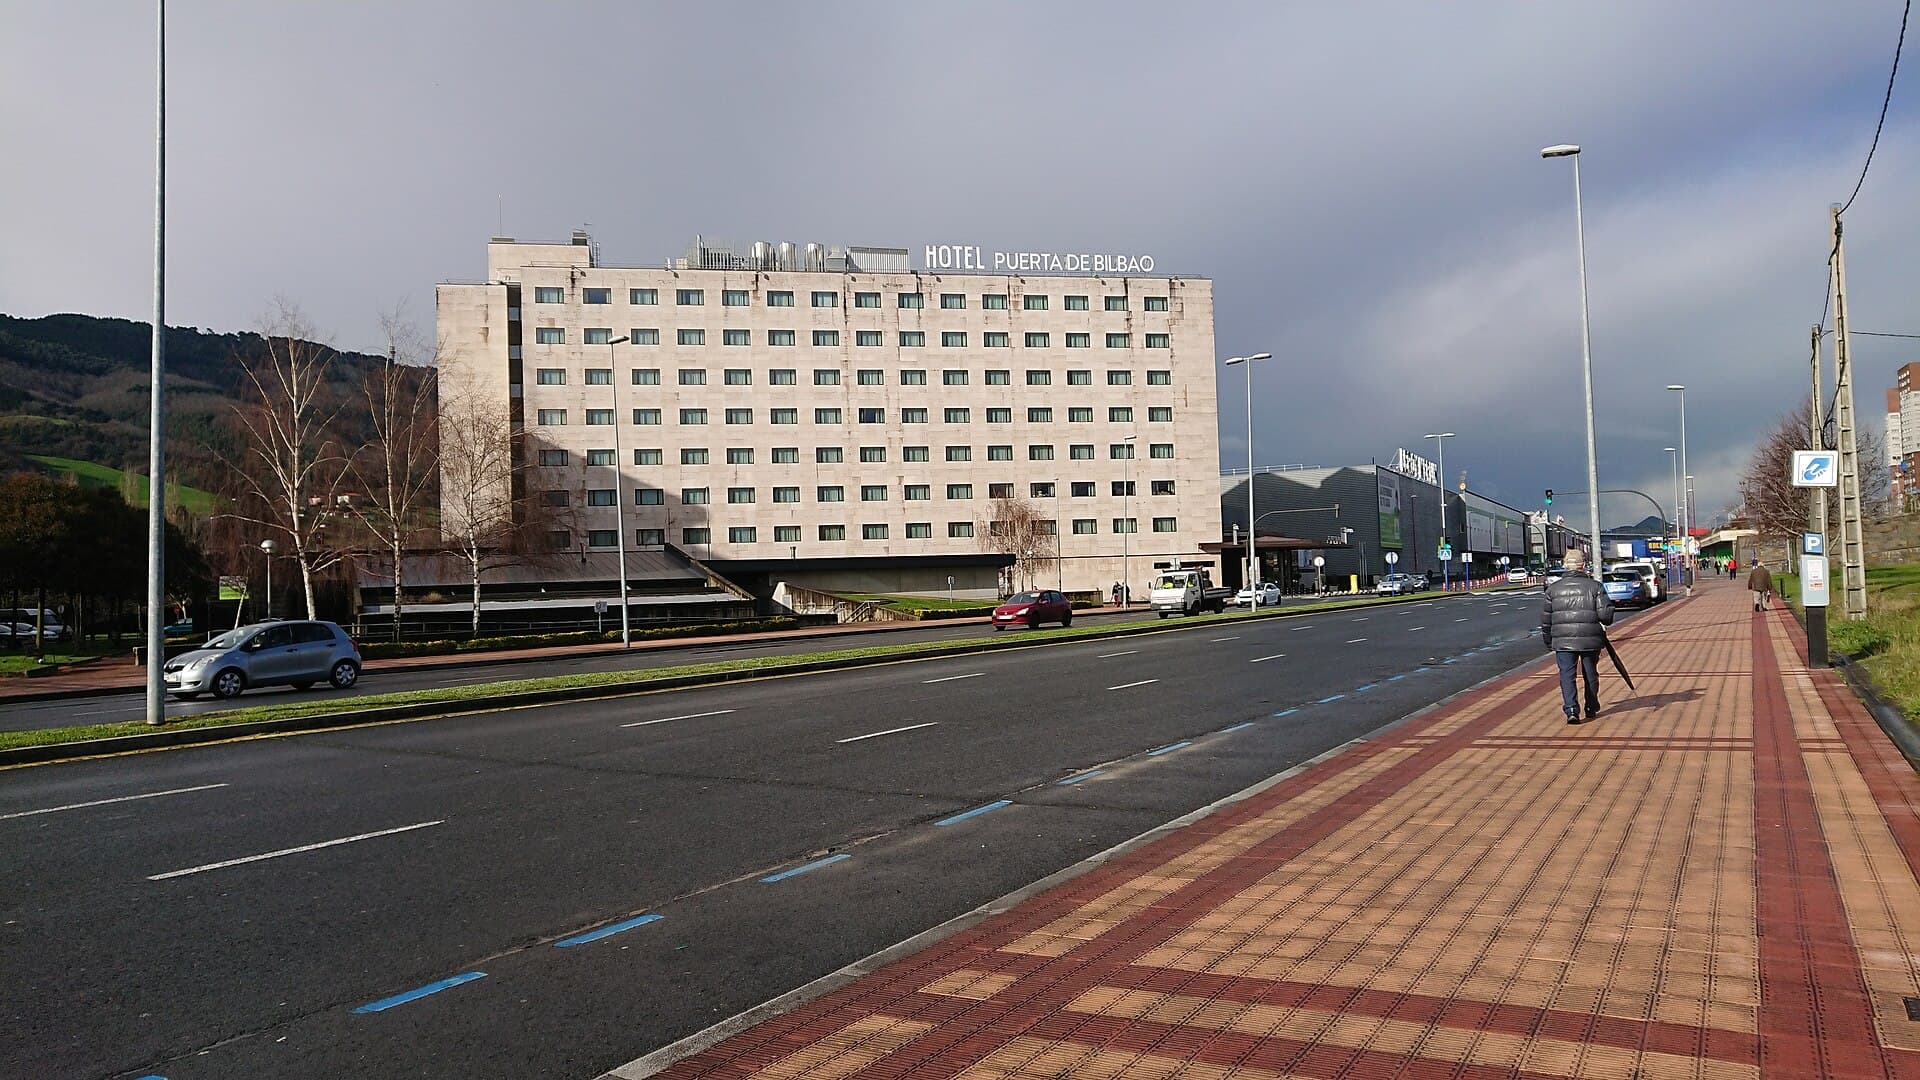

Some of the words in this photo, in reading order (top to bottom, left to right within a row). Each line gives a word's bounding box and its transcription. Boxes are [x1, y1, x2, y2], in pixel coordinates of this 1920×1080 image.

[926, 245, 985, 270] HOTEL
[994, 252, 1063, 271] PUERTA
[1067, 254, 1090, 272] DE
[1094, 254, 1154, 273] BILBAO
[1807, 536, 1821, 551] P
